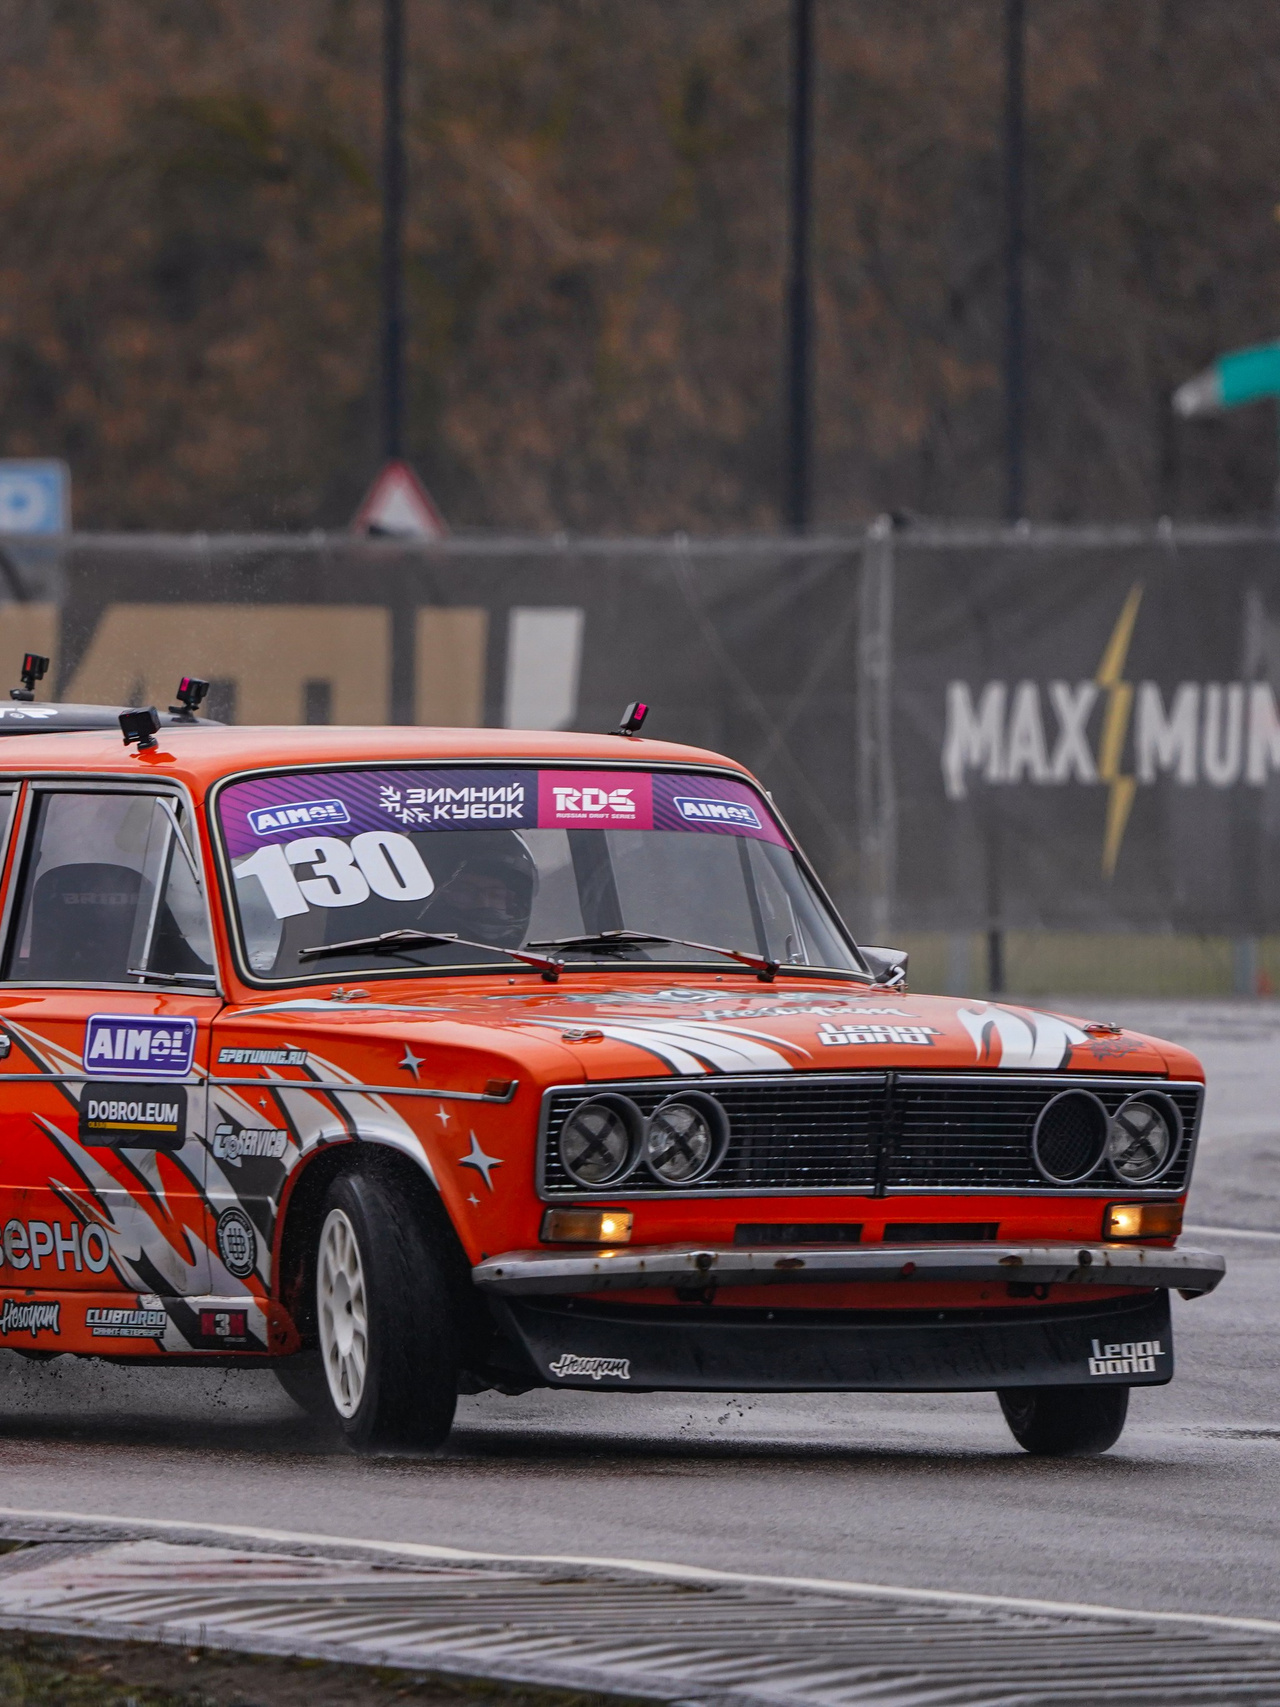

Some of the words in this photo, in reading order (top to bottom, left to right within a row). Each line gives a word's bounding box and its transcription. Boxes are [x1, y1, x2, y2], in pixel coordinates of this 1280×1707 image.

[406, 783, 524, 803] ЗИМНИЙ
[552, 787, 636, 812] RDS
[257, 803, 345, 831] AIMOL
[433, 803, 524, 820] КУБОК
[556, 812, 588, 820] RUSSIAN
[589, 812, 610, 820] DRIFT
[611, 812, 636, 820] SERIES
[683, 801, 756, 824] AIMOL
[232, 830, 435, 920] 130
[89, 1028, 189, 1062] AIMOL
[217, 1048, 307, 1065] SPBTUNING.RU
[87, 1100, 179, 1123] DOBROLEUM
[86, 1309, 167, 1326] CLUBTURBO
